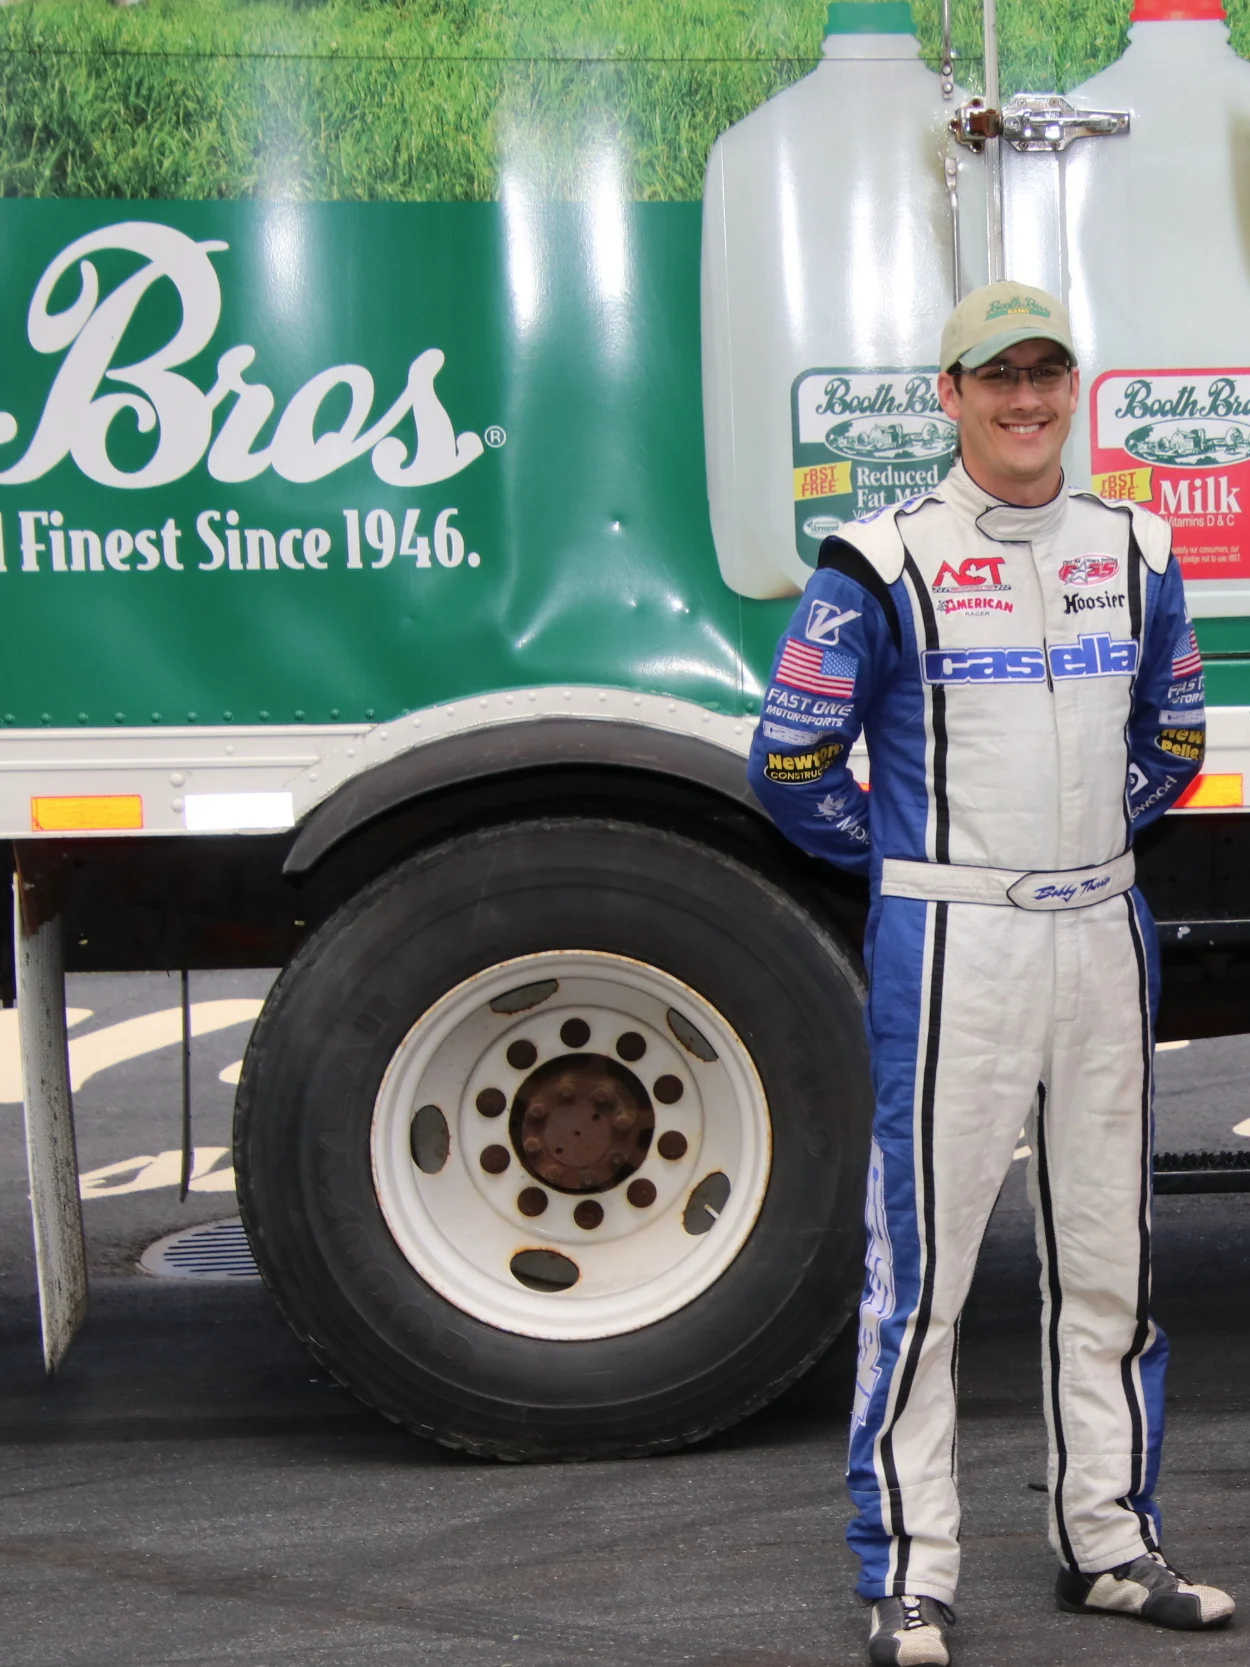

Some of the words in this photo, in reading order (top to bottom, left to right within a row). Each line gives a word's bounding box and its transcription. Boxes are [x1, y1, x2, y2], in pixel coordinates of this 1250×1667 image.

[815, 376, 899, 416] Booth
[1114, 379, 1199, 419] Booth
[803, 465, 838, 485] rBST
[856, 464, 939, 486] Reduced
[1101, 471, 1137, 489] rBST
[856, 489, 886, 508] Fat
[1158, 475, 1242, 515] Milk
[1165, 515, 1205, 528] Vitamins
[1206, 515, 1216, 526] D
[1216, 514, 1226, 526] &
[1226, 514, 1235, 526] C
[18, 509, 185, 573] Finest
[196, 508, 332, 572] Since
[342, 507, 481, 569] 1946.
[931, 556, 1006, 588] ACT
[945, 597, 1014, 615] AMERICAN
[1063, 590, 1126, 615] Hoosier
[767, 687, 812, 712] FAST
[812, 700, 854, 717] ONE
[765, 704, 845, 728] MOTORSPORTS
[768, 744, 841, 770] Newton
